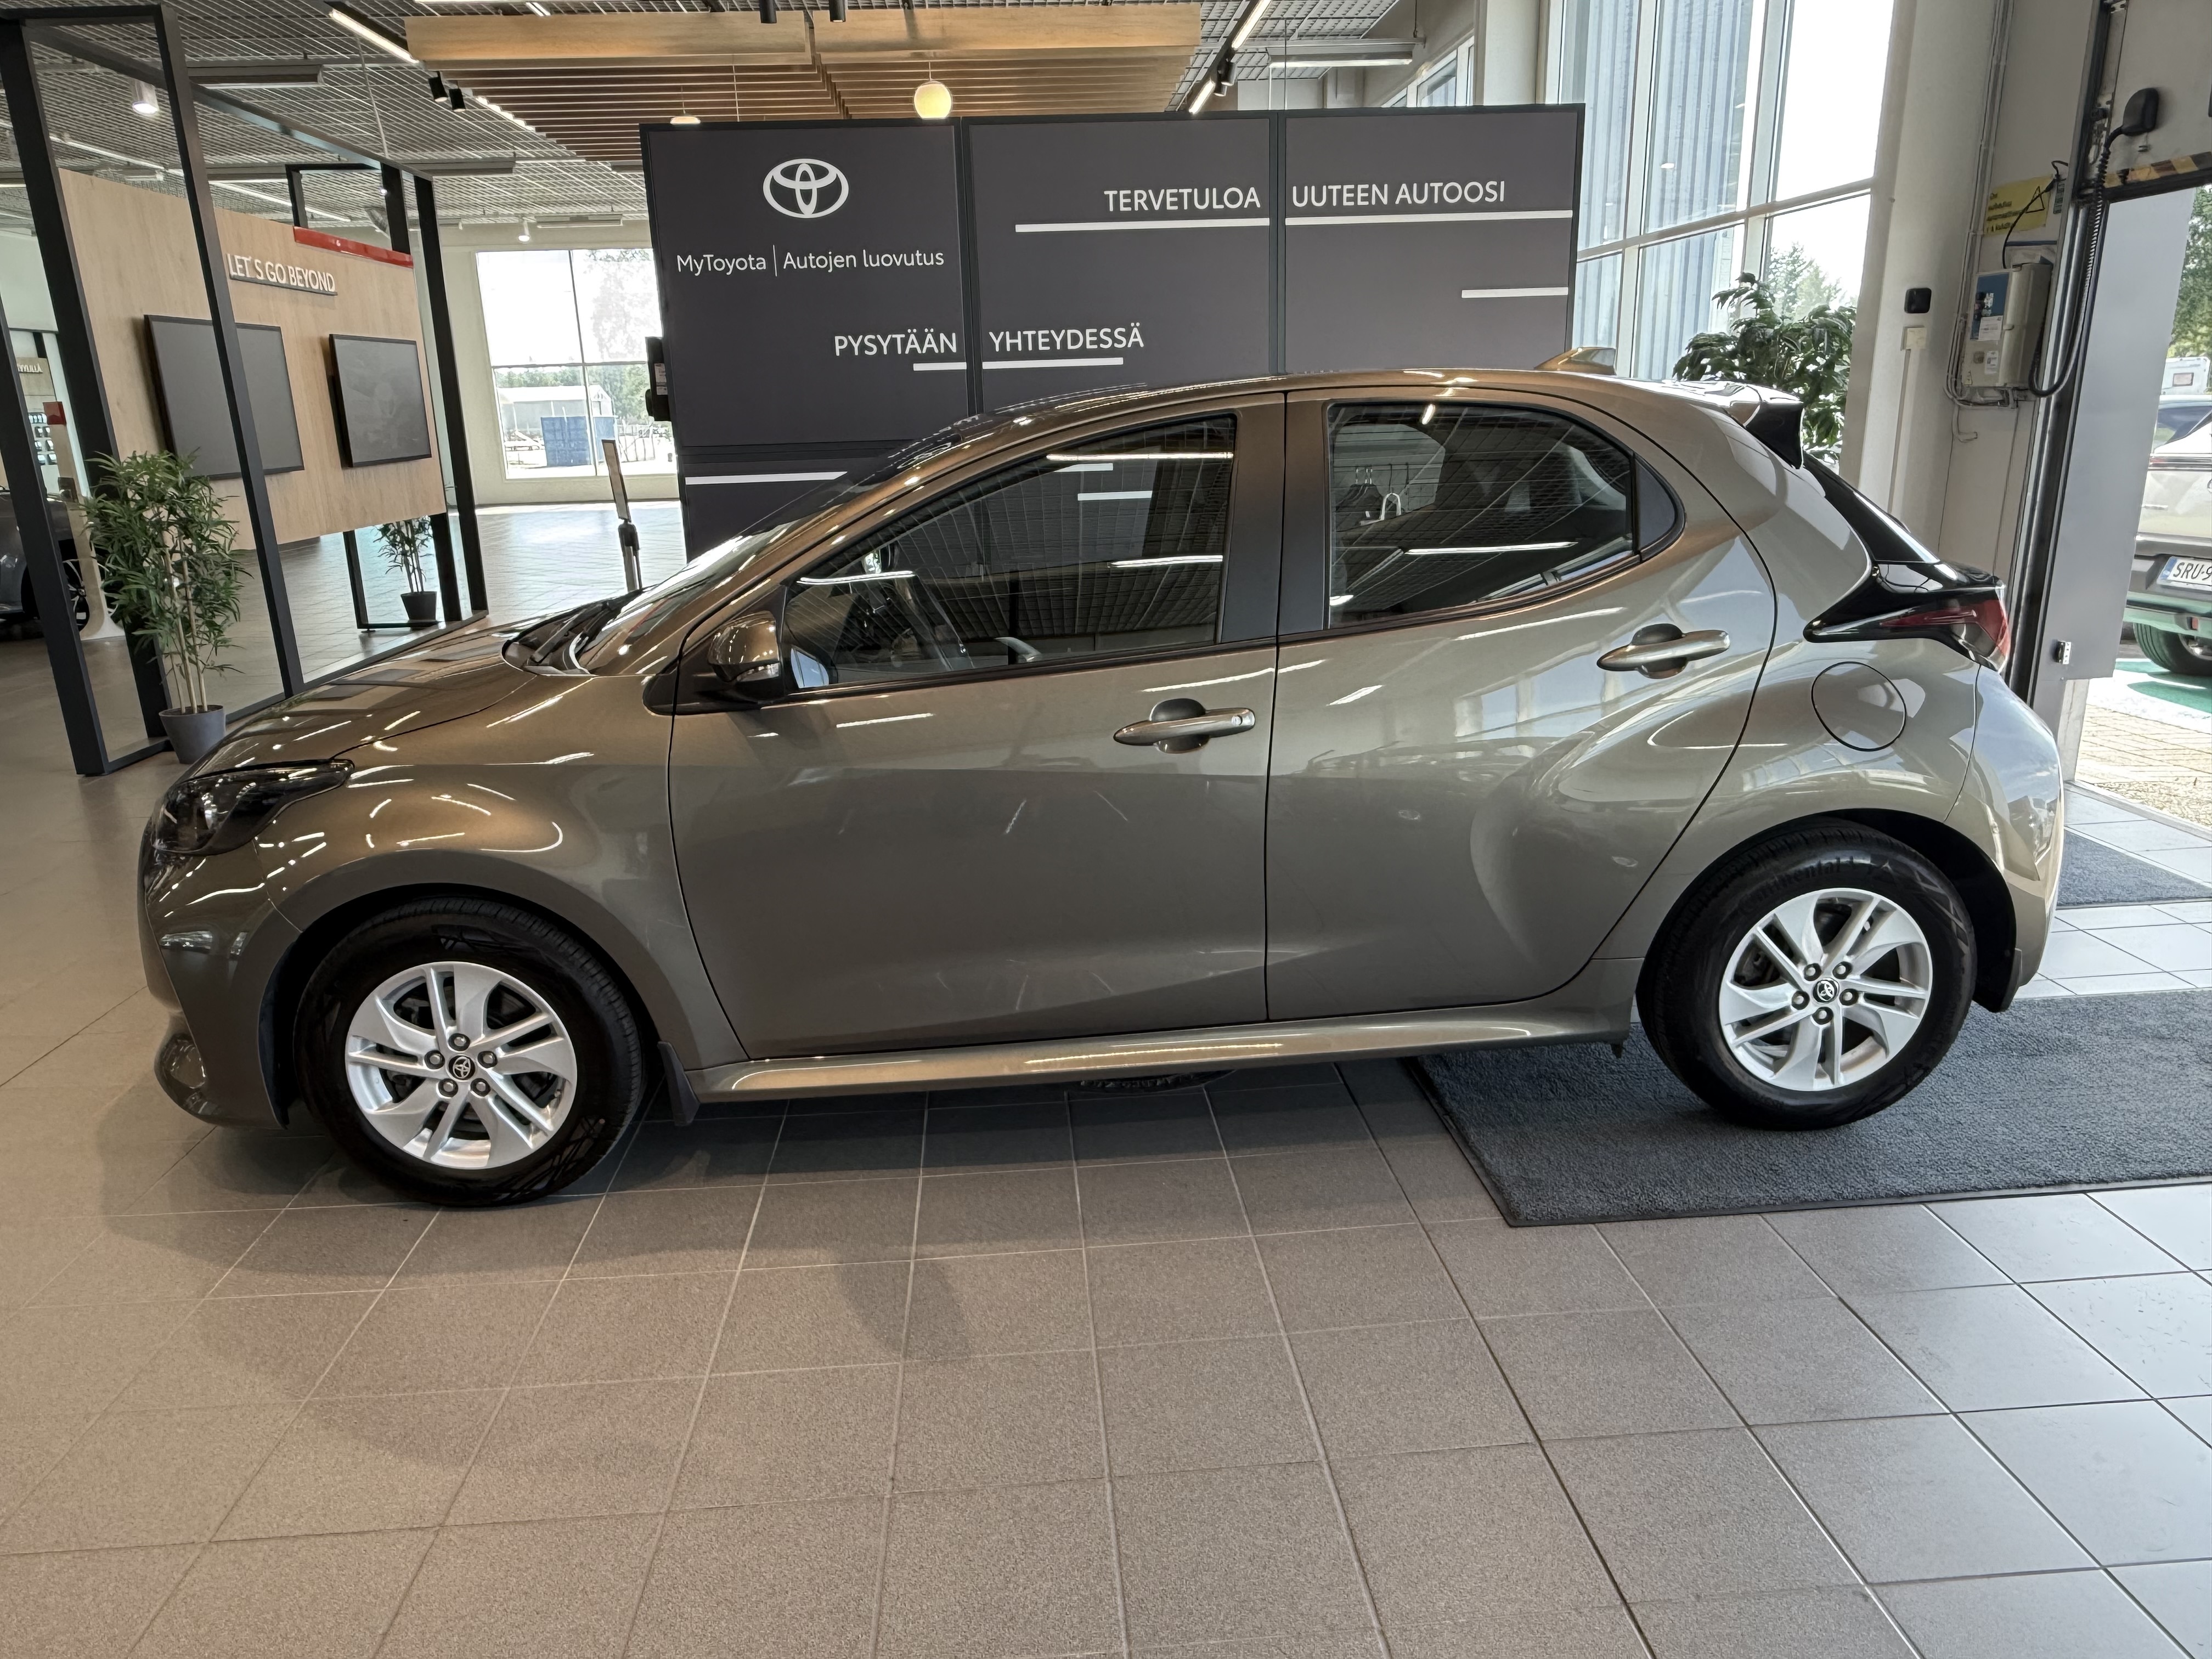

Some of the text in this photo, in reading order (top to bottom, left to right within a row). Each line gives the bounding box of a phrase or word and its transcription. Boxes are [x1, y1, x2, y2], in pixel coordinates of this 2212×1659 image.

[1104, 180, 1505, 212] TERVETULOA UUTEEN AUTOOSI
[265, 261, 286, 284] GO
[287, 266, 335, 292] BEYOND
[676, 249, 944, 276] MyToyota Autojen luovutus
[834, 322, 1144, 356] PYSYTÄÄN YHTEYDESSÄ
